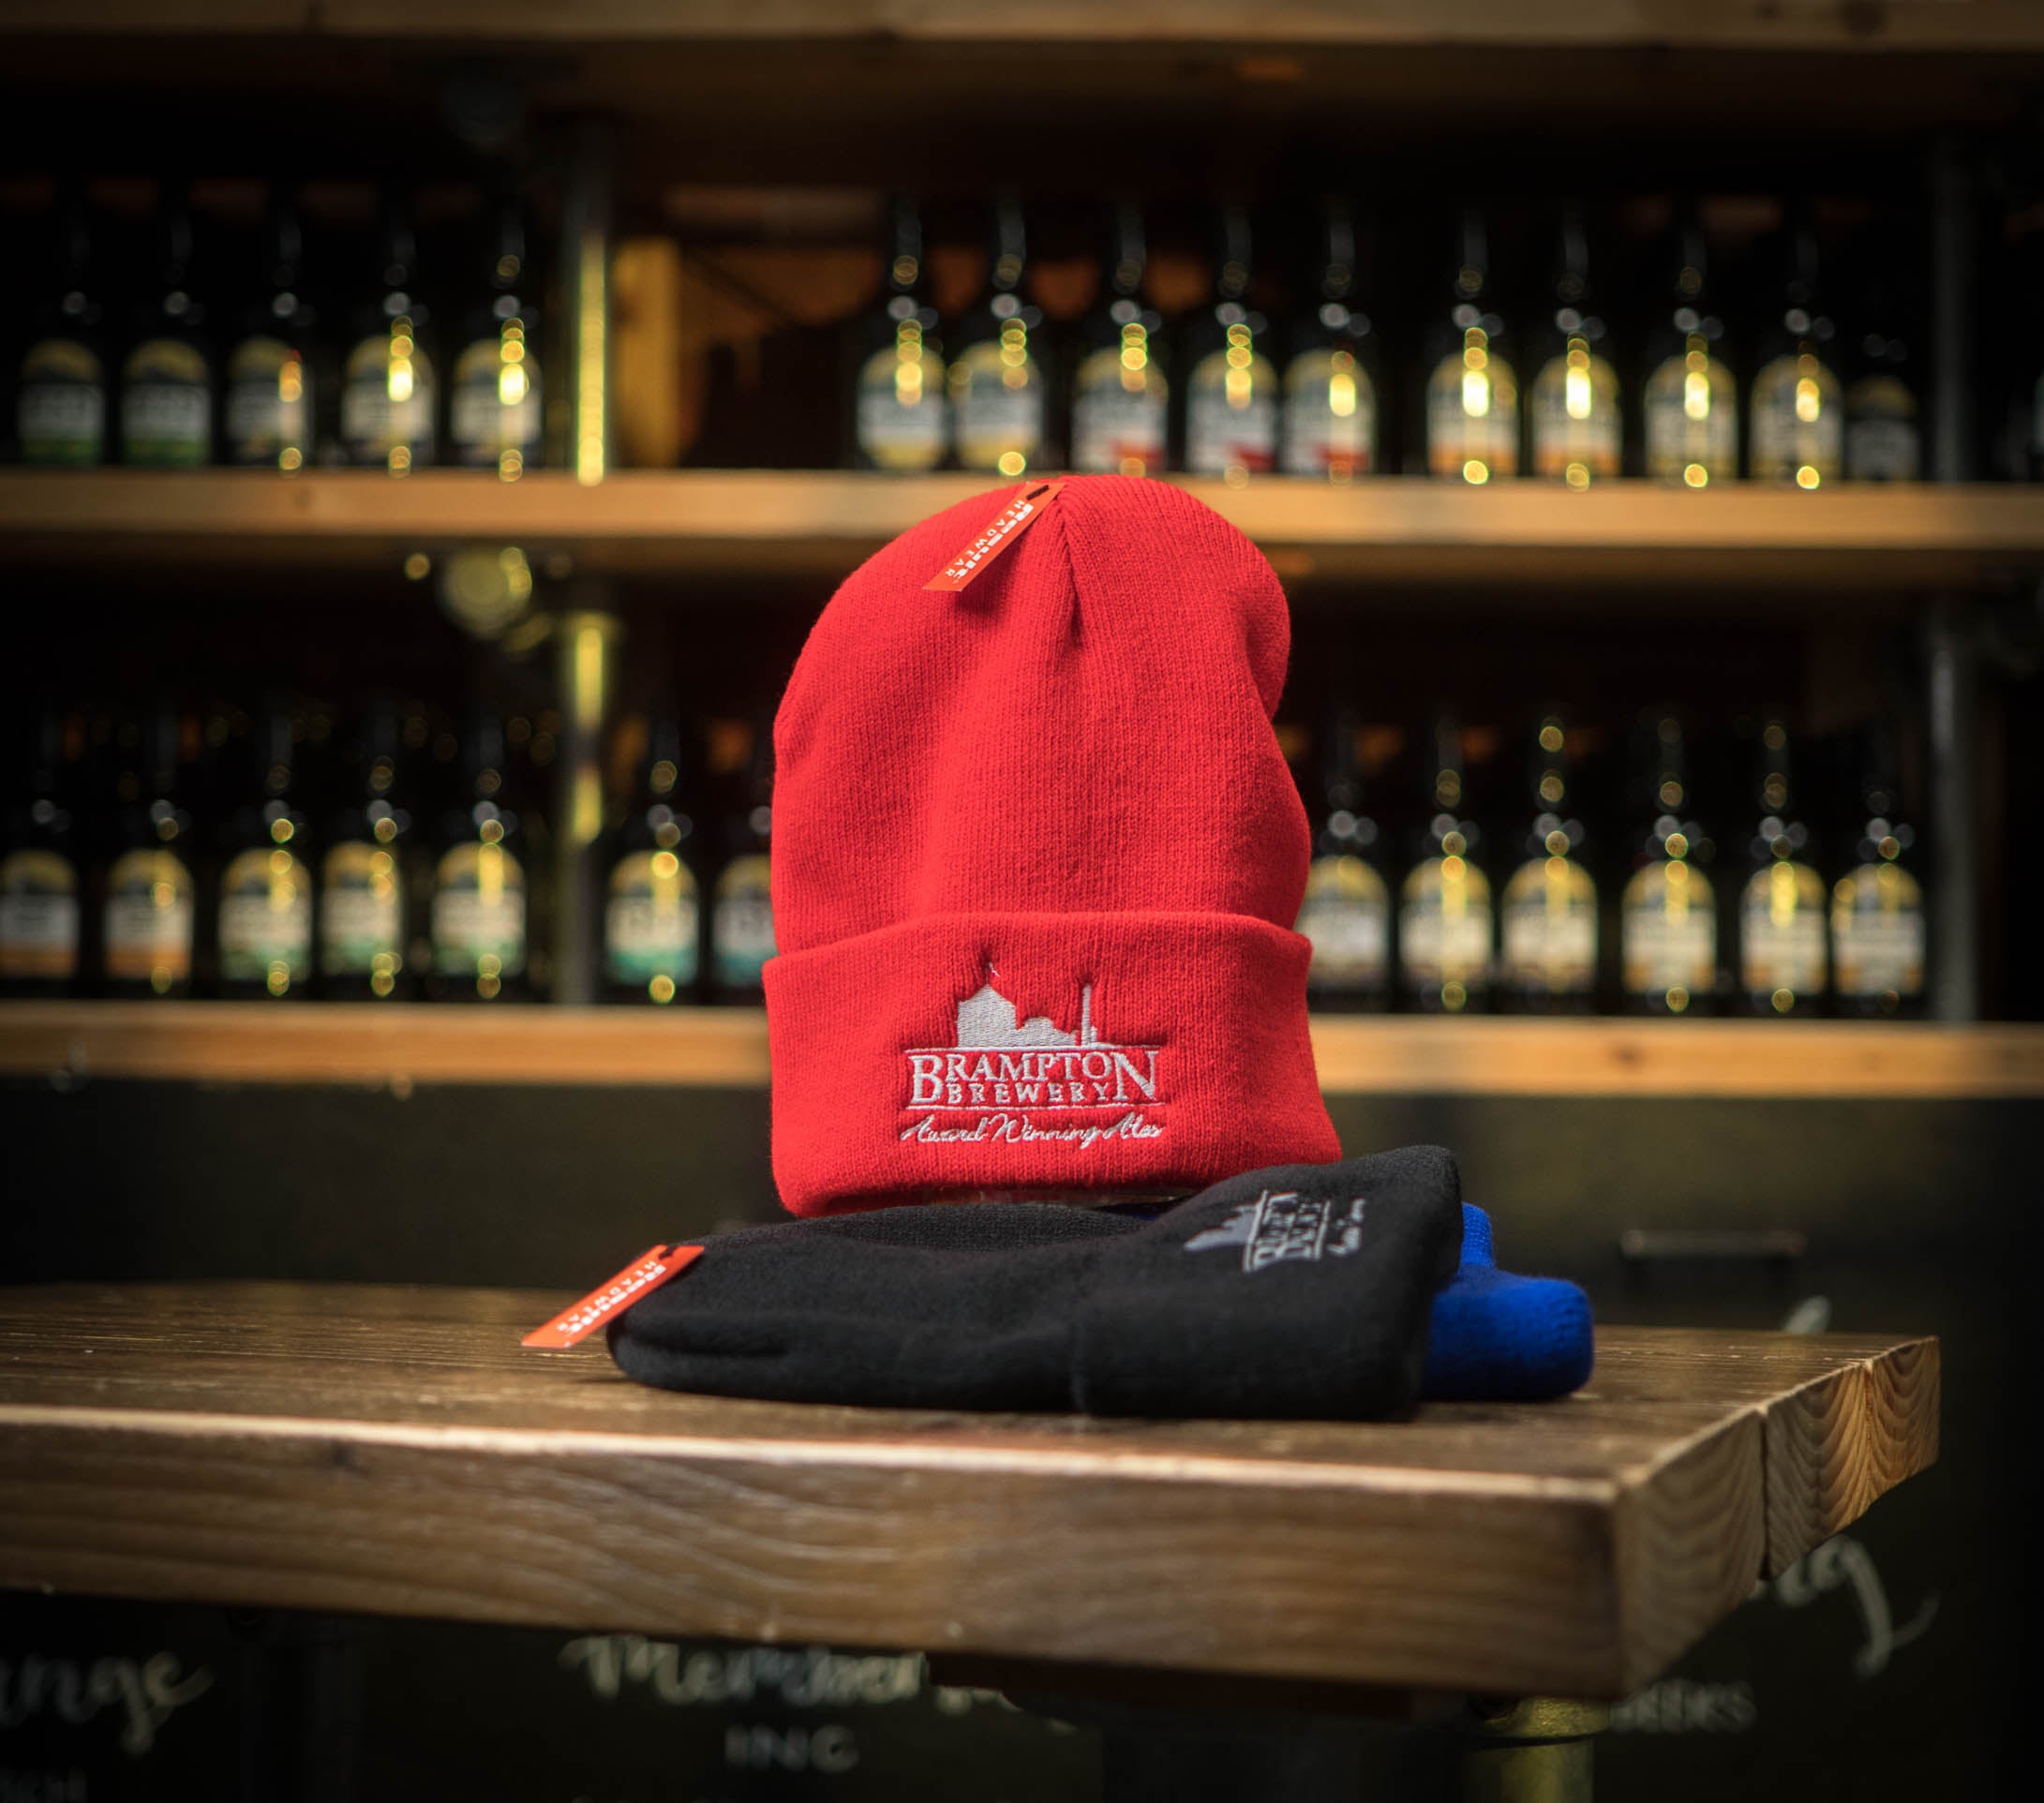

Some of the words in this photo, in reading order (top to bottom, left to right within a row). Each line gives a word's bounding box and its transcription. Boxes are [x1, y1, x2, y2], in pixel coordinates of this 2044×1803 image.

[945, 499, 1024, 577] HEADWEAR
[908, 1051, 1159, 1104] BRAMPTON
[945, 1081, 1110, 1105] BREWERY
[900, 1114, 988, 1142] Award
[990, 1112, 1102, 1150] Winning
[1102, 1111, 1167, 1140] Ales
